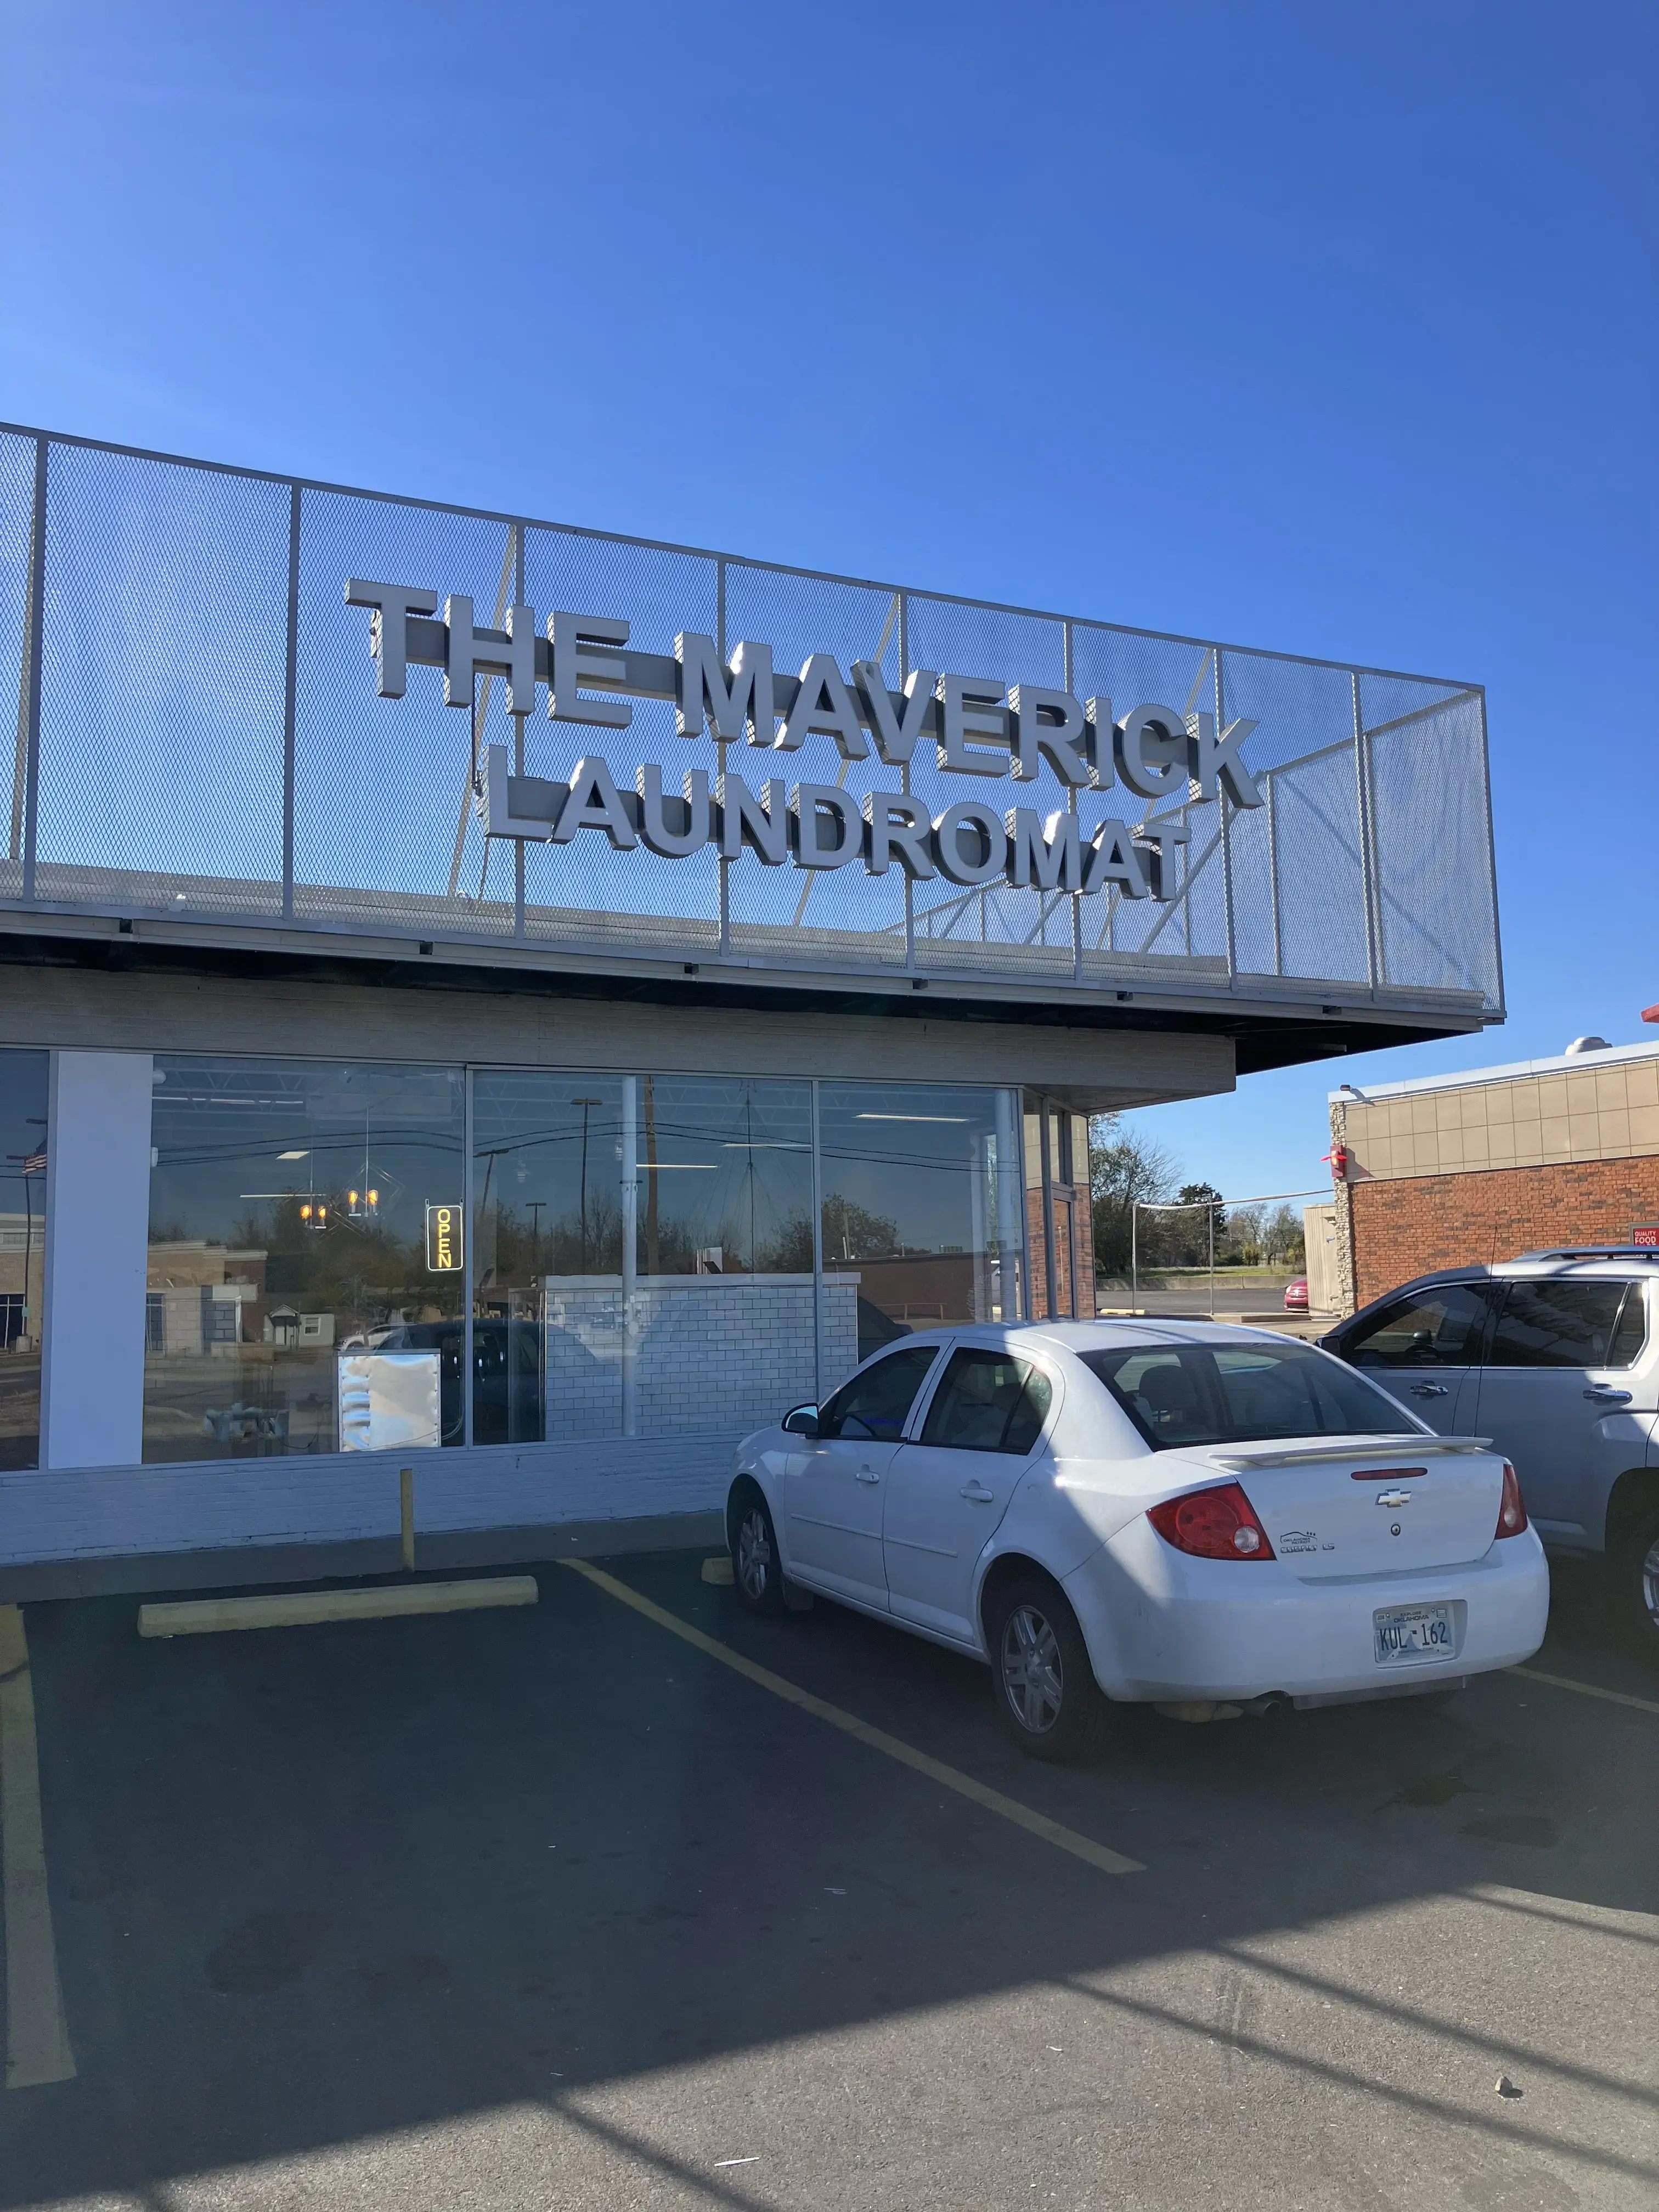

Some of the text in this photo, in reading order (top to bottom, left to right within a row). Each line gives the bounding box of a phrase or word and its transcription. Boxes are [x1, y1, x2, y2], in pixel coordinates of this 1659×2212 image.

[345, 578, 1265, 809] THE MAVERICK
[482, 744, 1191, 903] LAUNDROMAT
[437, 1209, 452, 1268] OPEN
[1635, 1236, 1656, 1244] FOOD
[1393, 1615, 1429, 1623] OKLAHOMA
